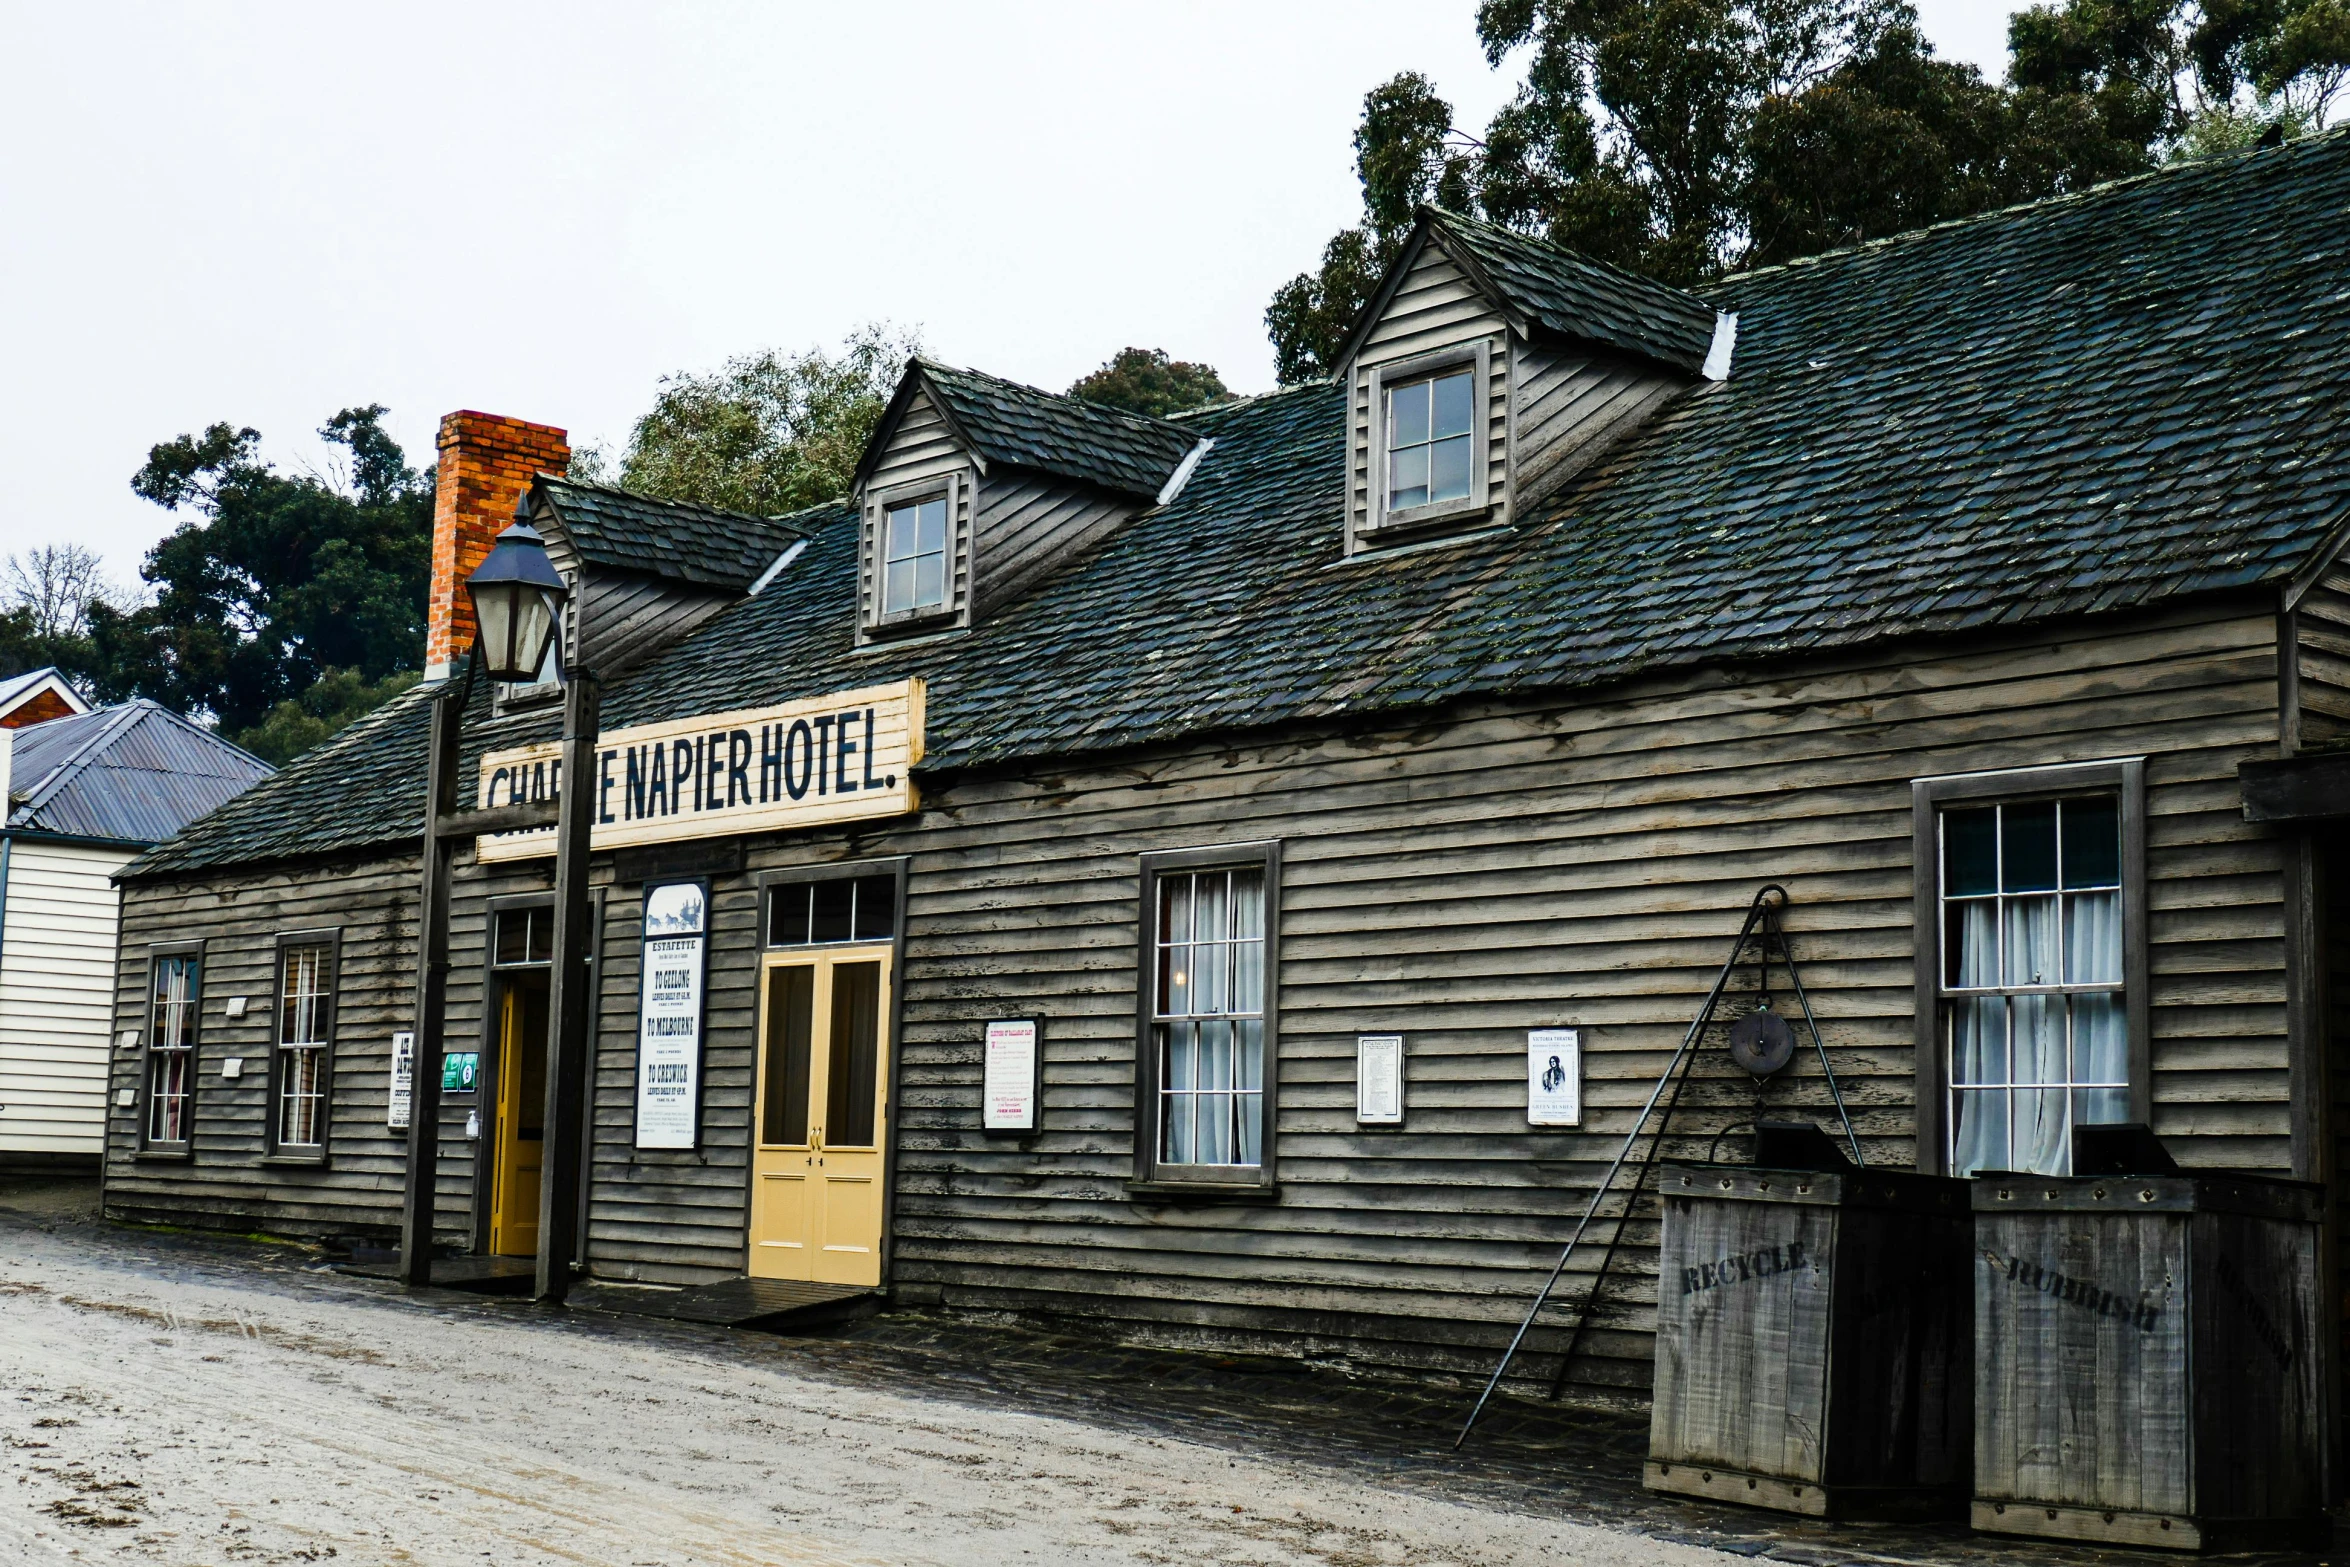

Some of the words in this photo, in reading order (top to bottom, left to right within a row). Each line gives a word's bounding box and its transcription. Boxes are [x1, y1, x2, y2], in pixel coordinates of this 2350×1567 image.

[487, 750, 617, 838] CHAIE
[625, 728, 753, 822] NAPIER
[759, 708, 896, 804] HOTEL.
[652, 940, 696, 952] ESTAFETTE
[655, 970, 662, 989] TO
[664, 969, 690, 989] GEELONG
[648, 1018, 655, 1036] TO
[656, 1017, 693, 1036] MELBOURNE
[648, 1064, 656, 1083] TO
[657, 1064, 688, 1083] CRESWICK
[648, 1087, 660, 1095] LEAVES
[1680, 1241, 1808, 1295] RECYCLE
[2007, 1256, 2160, 1333] RUBBISH
